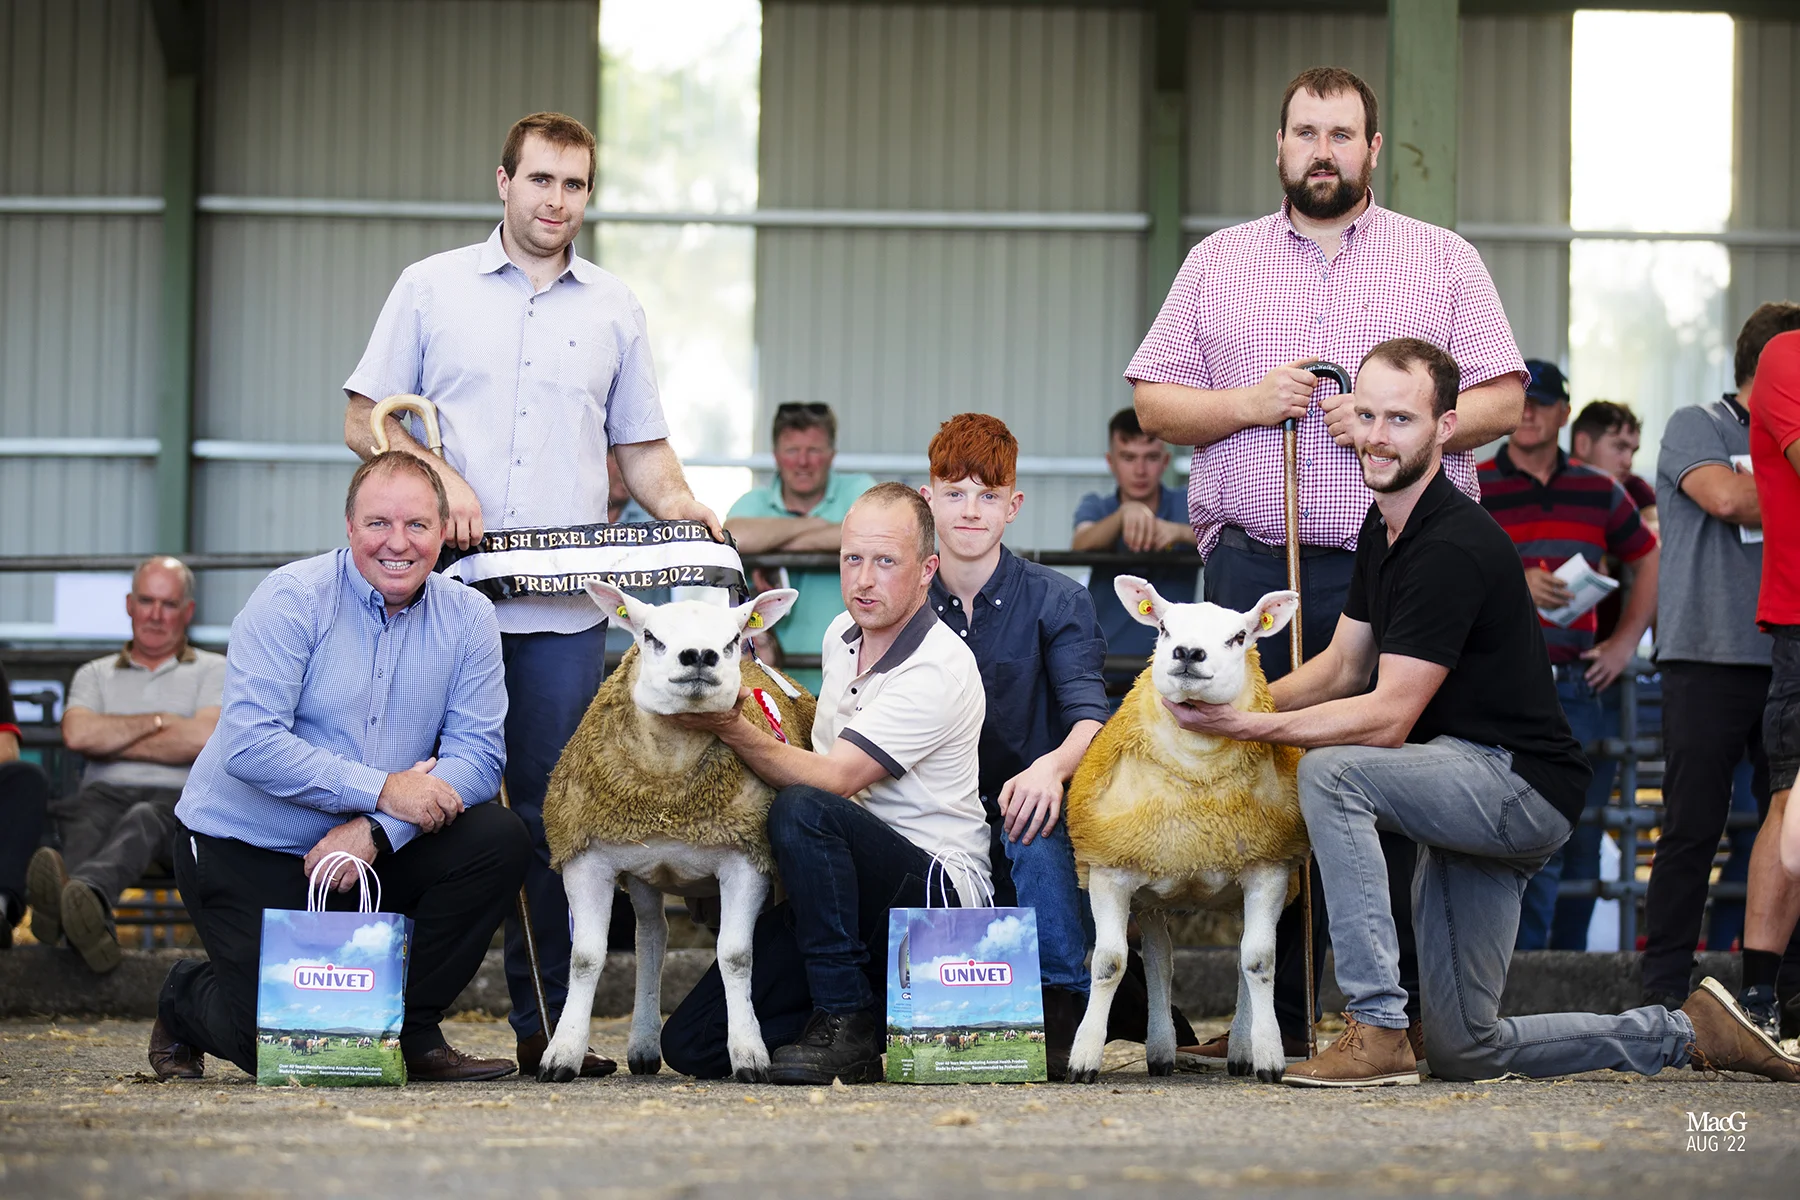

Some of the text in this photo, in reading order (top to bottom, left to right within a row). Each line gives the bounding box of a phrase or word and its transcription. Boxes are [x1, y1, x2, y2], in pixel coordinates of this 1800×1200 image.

[536, 532, 590, 548] TEXEL
[594, 527, 647, 545] SHEEP
[652, 525, 711, 543] SOCIET
[607, 572, 653, 588] SALE
[658, 567, 704, 585] 2022
[298, 966, 370, 988] UNIVET
[944, 961, 1007, 983] UNIVET
